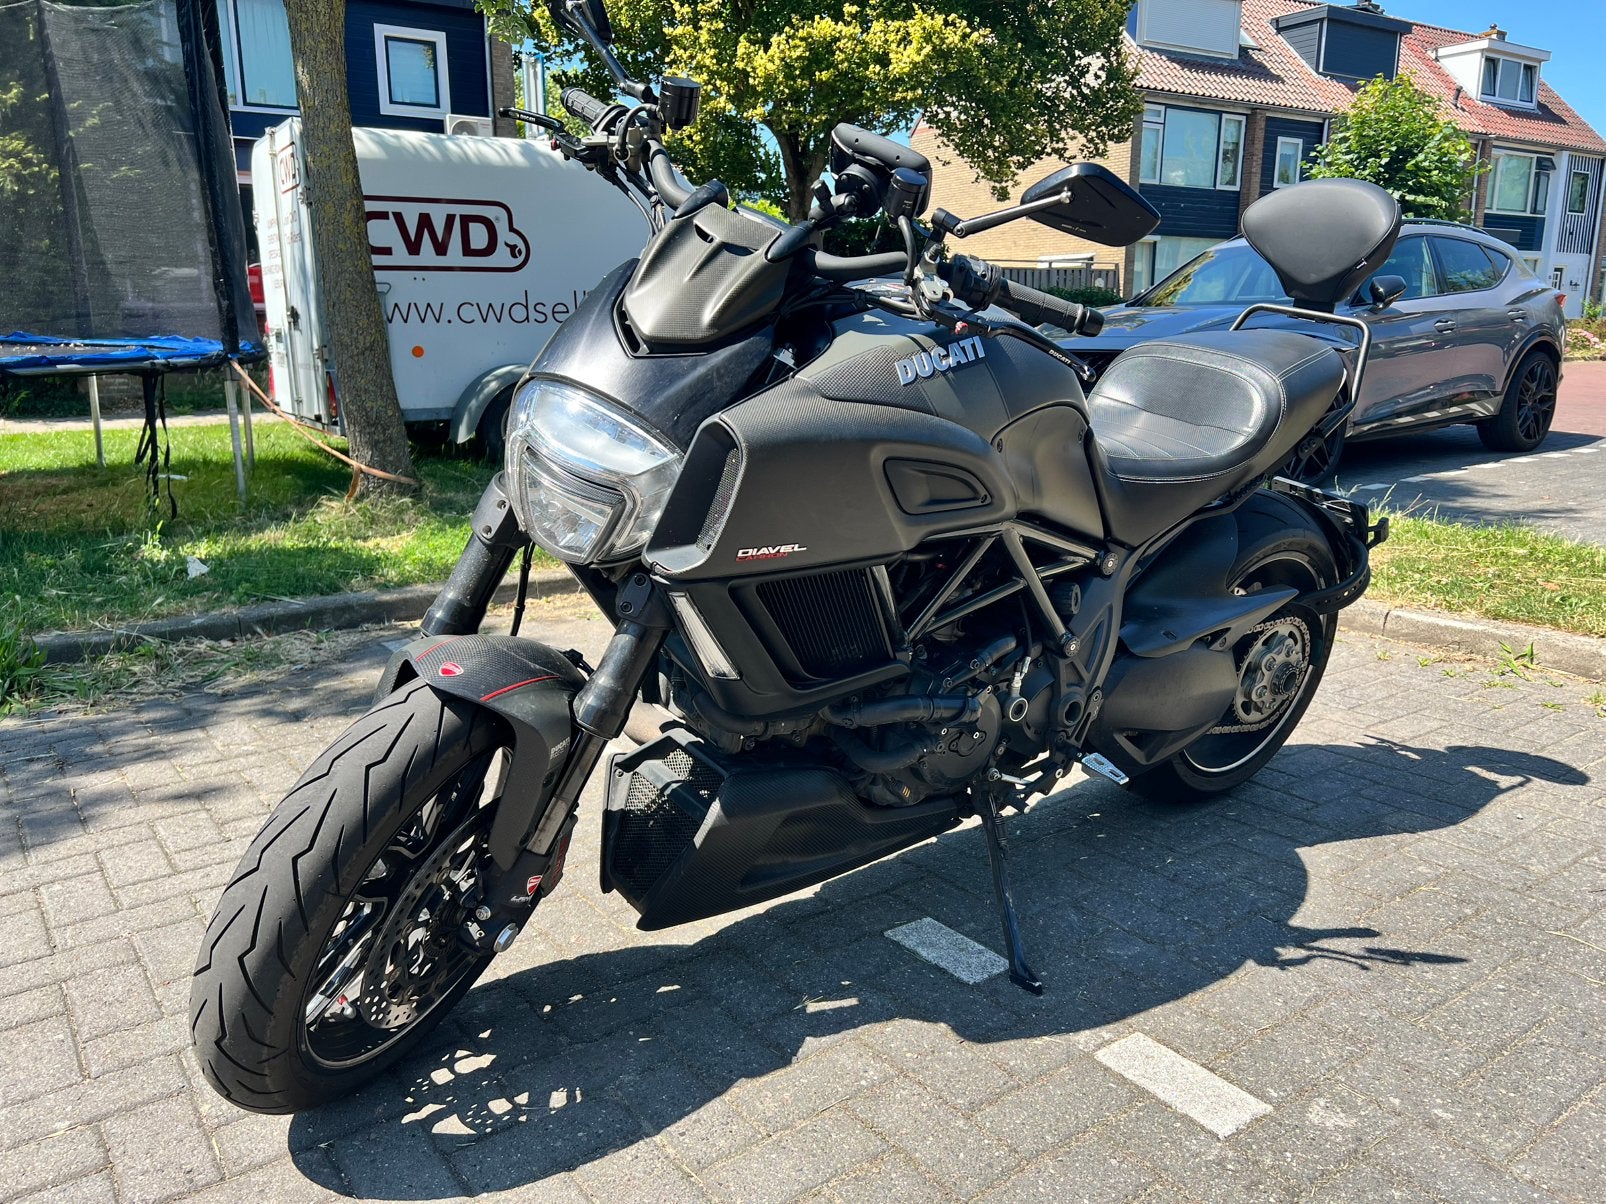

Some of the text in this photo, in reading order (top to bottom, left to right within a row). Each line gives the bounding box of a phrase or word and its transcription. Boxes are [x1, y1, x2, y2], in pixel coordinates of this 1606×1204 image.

[366, 211, 498, 257] CWD
[384, 289, 587, 324] ww.cwdsel
[895, 335, 985, 386] DUCATI
[1048, 349, 1071, 365] DUCATI
[737, 543, 807, 557] DIAVEL
